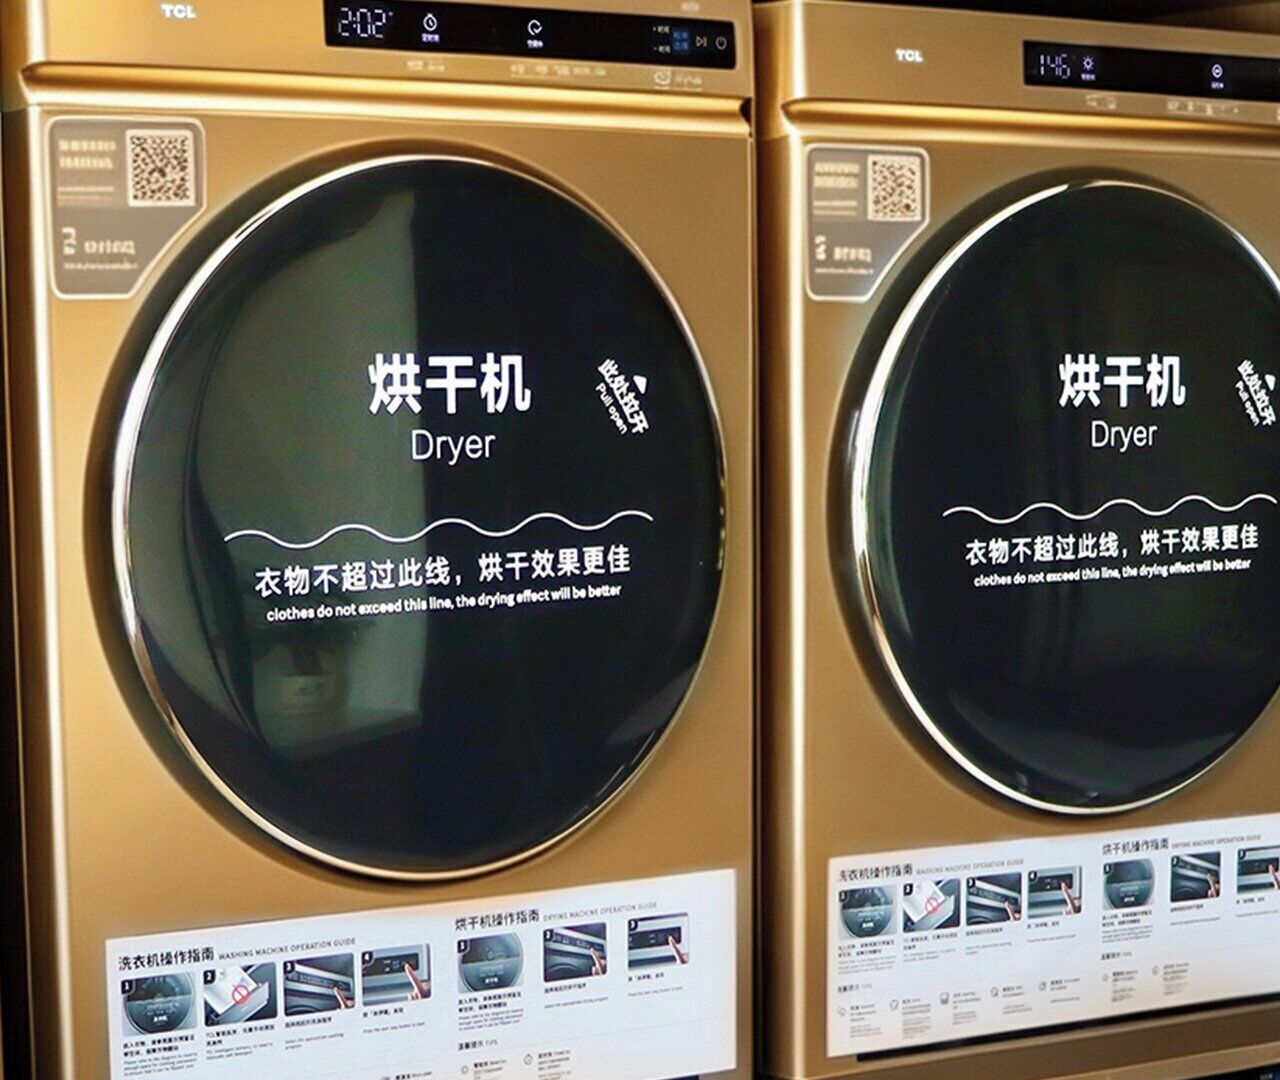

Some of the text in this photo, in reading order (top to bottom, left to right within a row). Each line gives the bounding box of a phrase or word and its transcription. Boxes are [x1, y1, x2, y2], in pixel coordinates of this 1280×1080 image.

[161, 4, 196, 19] TCL
[895, 48, 923, 63] TCL
[367, 352, 532, 416] 烘干机
[597, 359, 649, 435] 此处拉开
[1058, 354, 1186, 409] 烘干机
[595, 382, 628, 435] Pull open
[411, 430, 496, 466] Dryer
[1090, 420, 1158, 453] Dryer
[965, 523, 1259, 566] 衣物不超过此线，烘干效果更佳
[255, 544, 630, 599] 衣物不超过此线，烘干效果更佳
[266, 584, 622, 622] clothes do not exceed this line, the drying effect will be better
[455, 908, 540, 932] 烘干机操作指南
[118, 947, 215, 971] 洗衣机操作指南
